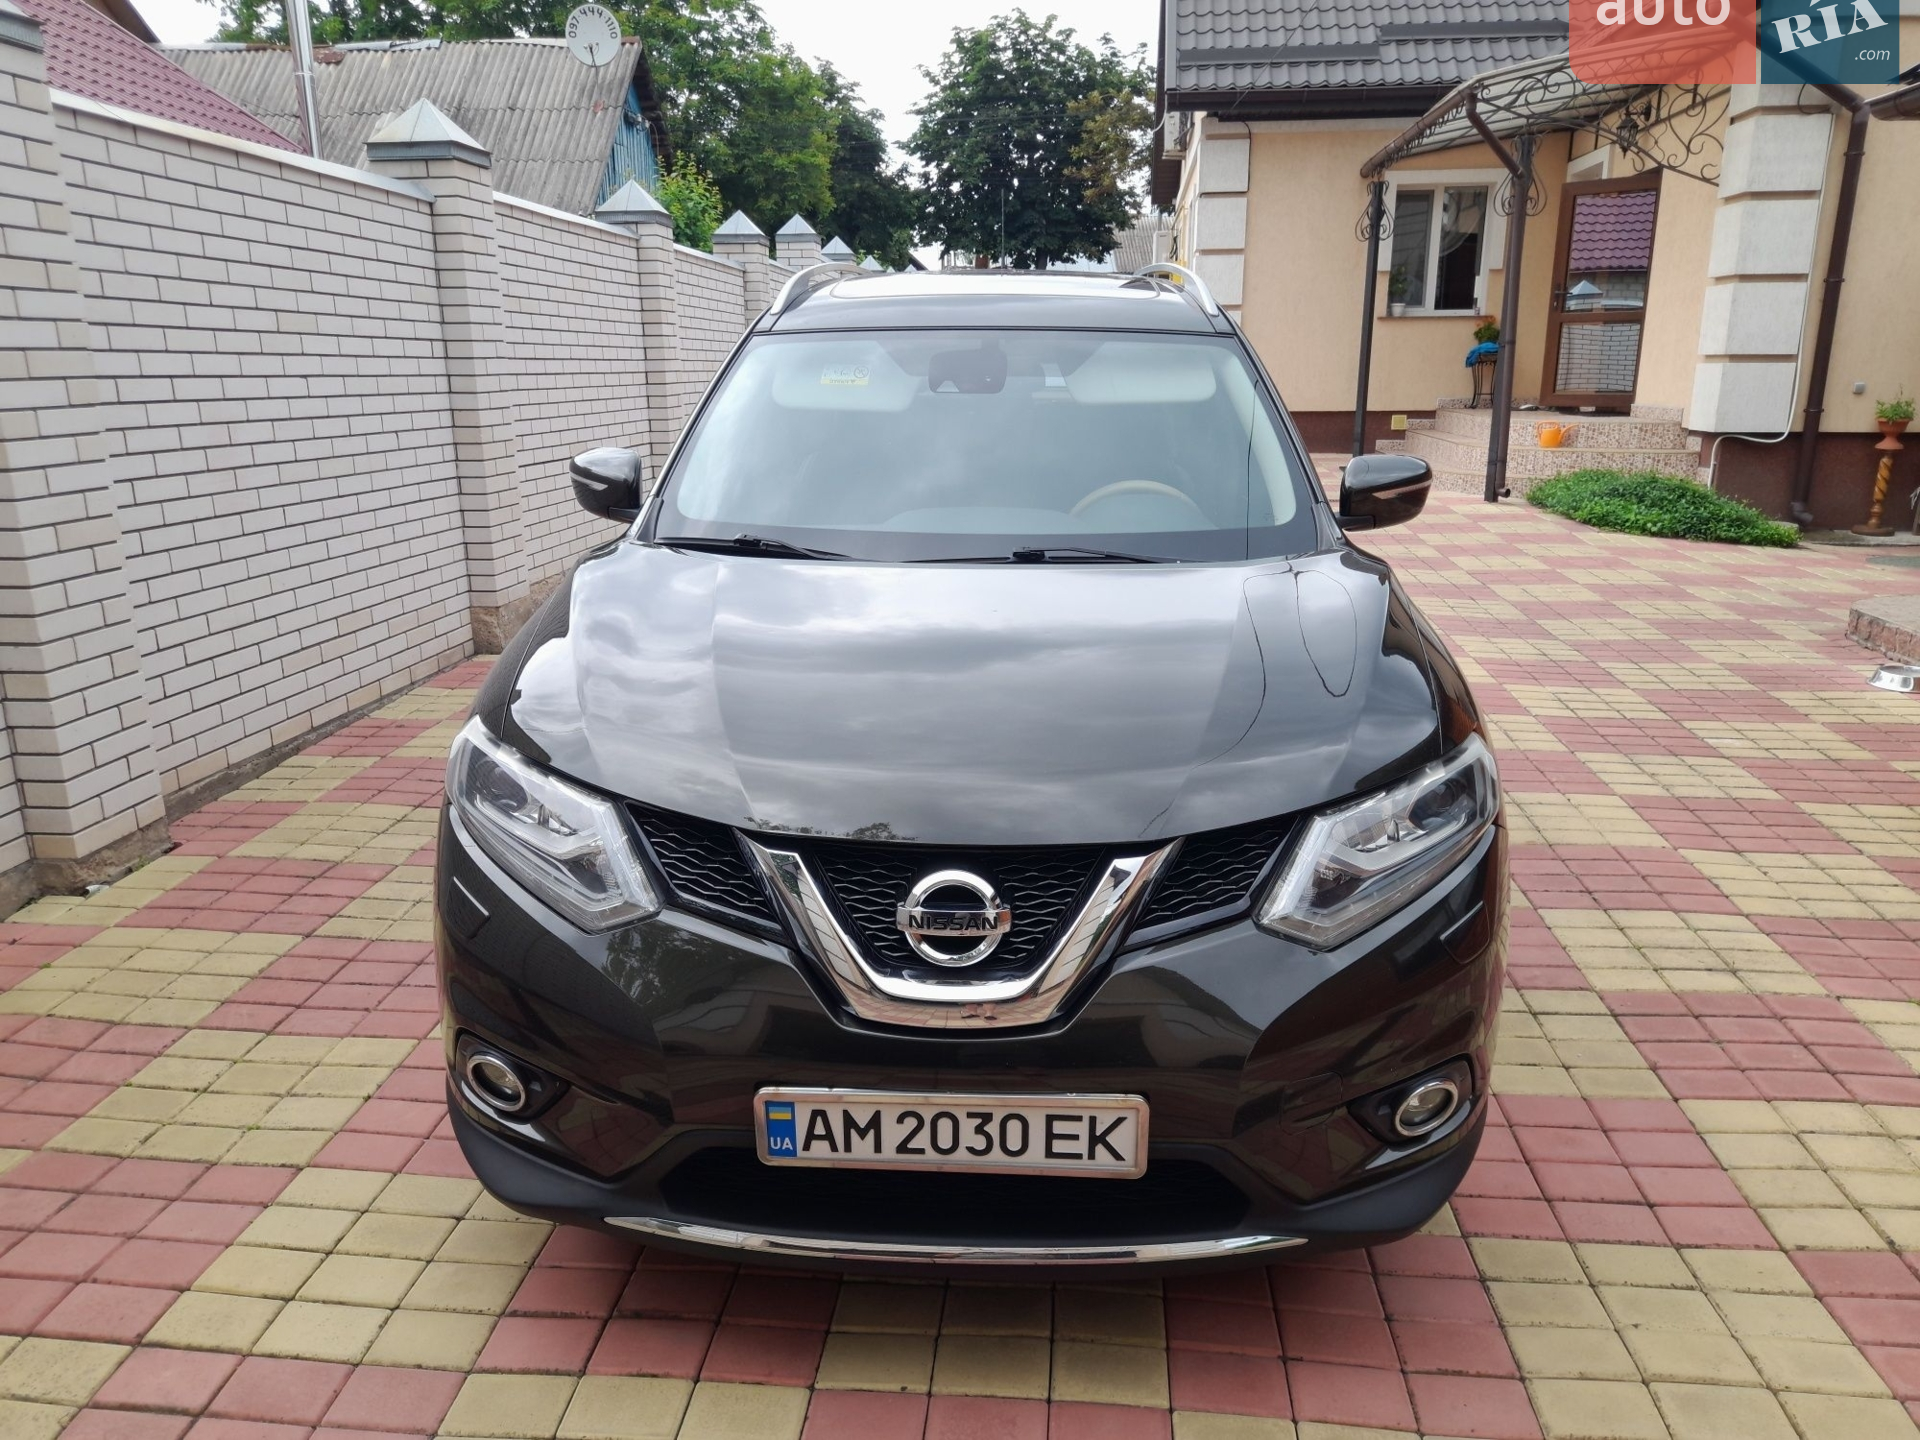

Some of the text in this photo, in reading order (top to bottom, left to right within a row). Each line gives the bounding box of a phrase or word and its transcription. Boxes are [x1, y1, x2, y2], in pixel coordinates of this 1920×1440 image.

[908, 914, 998, 931] NISSAN
[770, 1137, 793, 1150] UA
[802, 1109, 1127, 1161] AM 2030 EK
